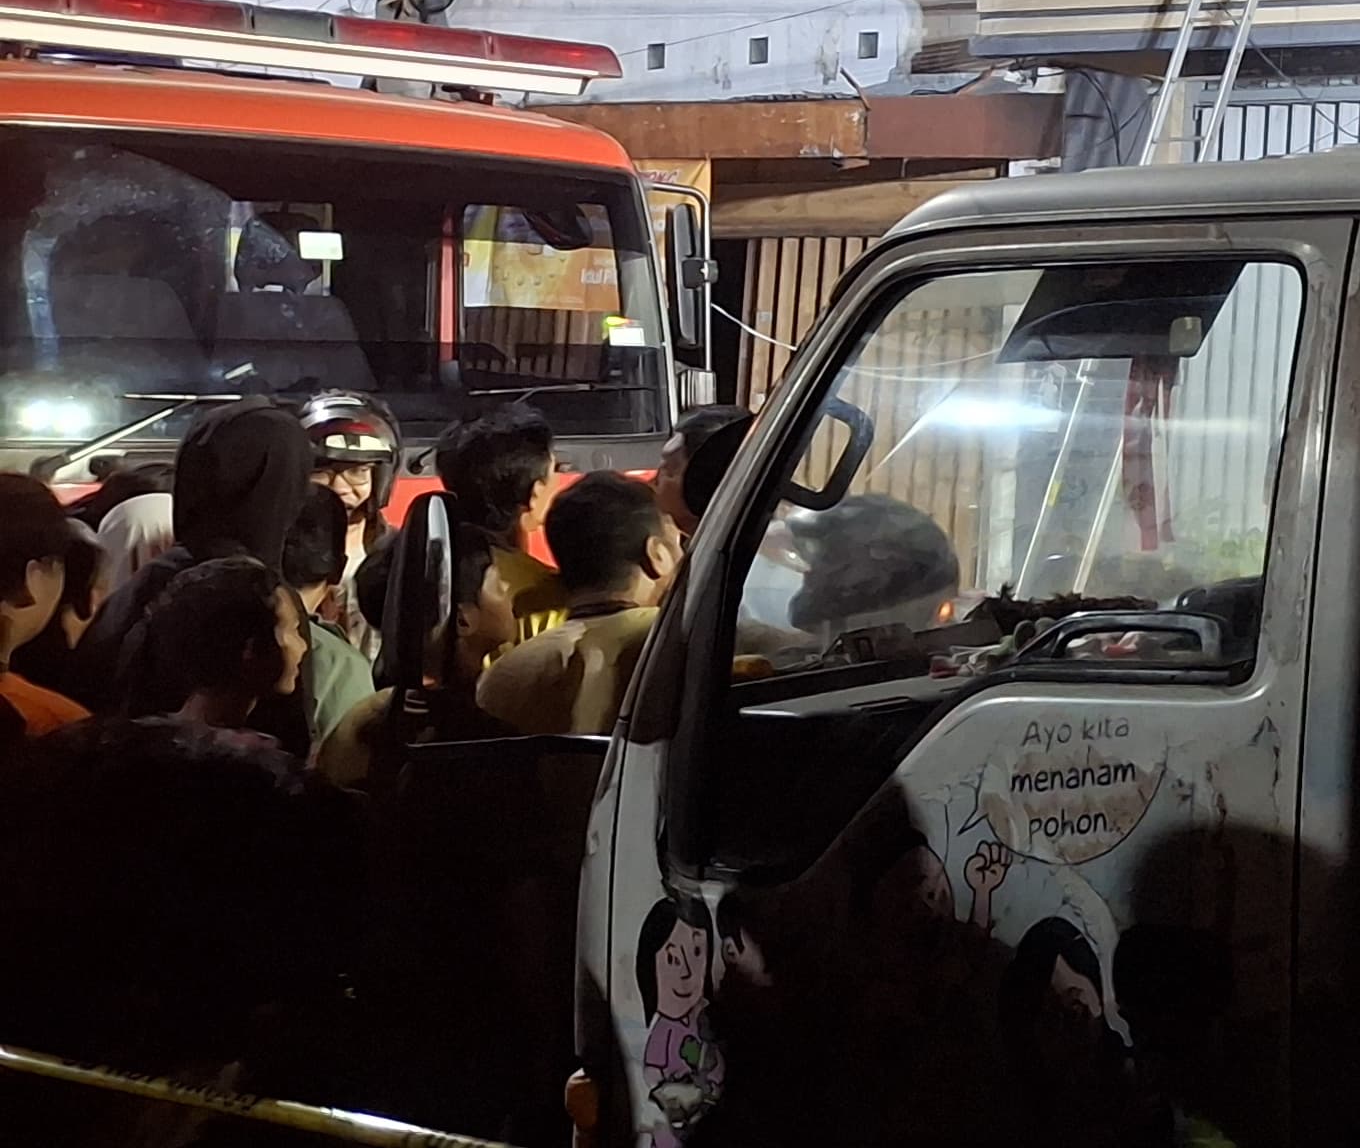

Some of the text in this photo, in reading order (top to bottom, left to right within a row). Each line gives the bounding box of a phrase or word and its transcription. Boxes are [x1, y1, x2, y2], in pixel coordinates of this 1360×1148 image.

[1022, 717, 1130, 752] Ayo kita
[1010, 762, 1137, 793] menanam
